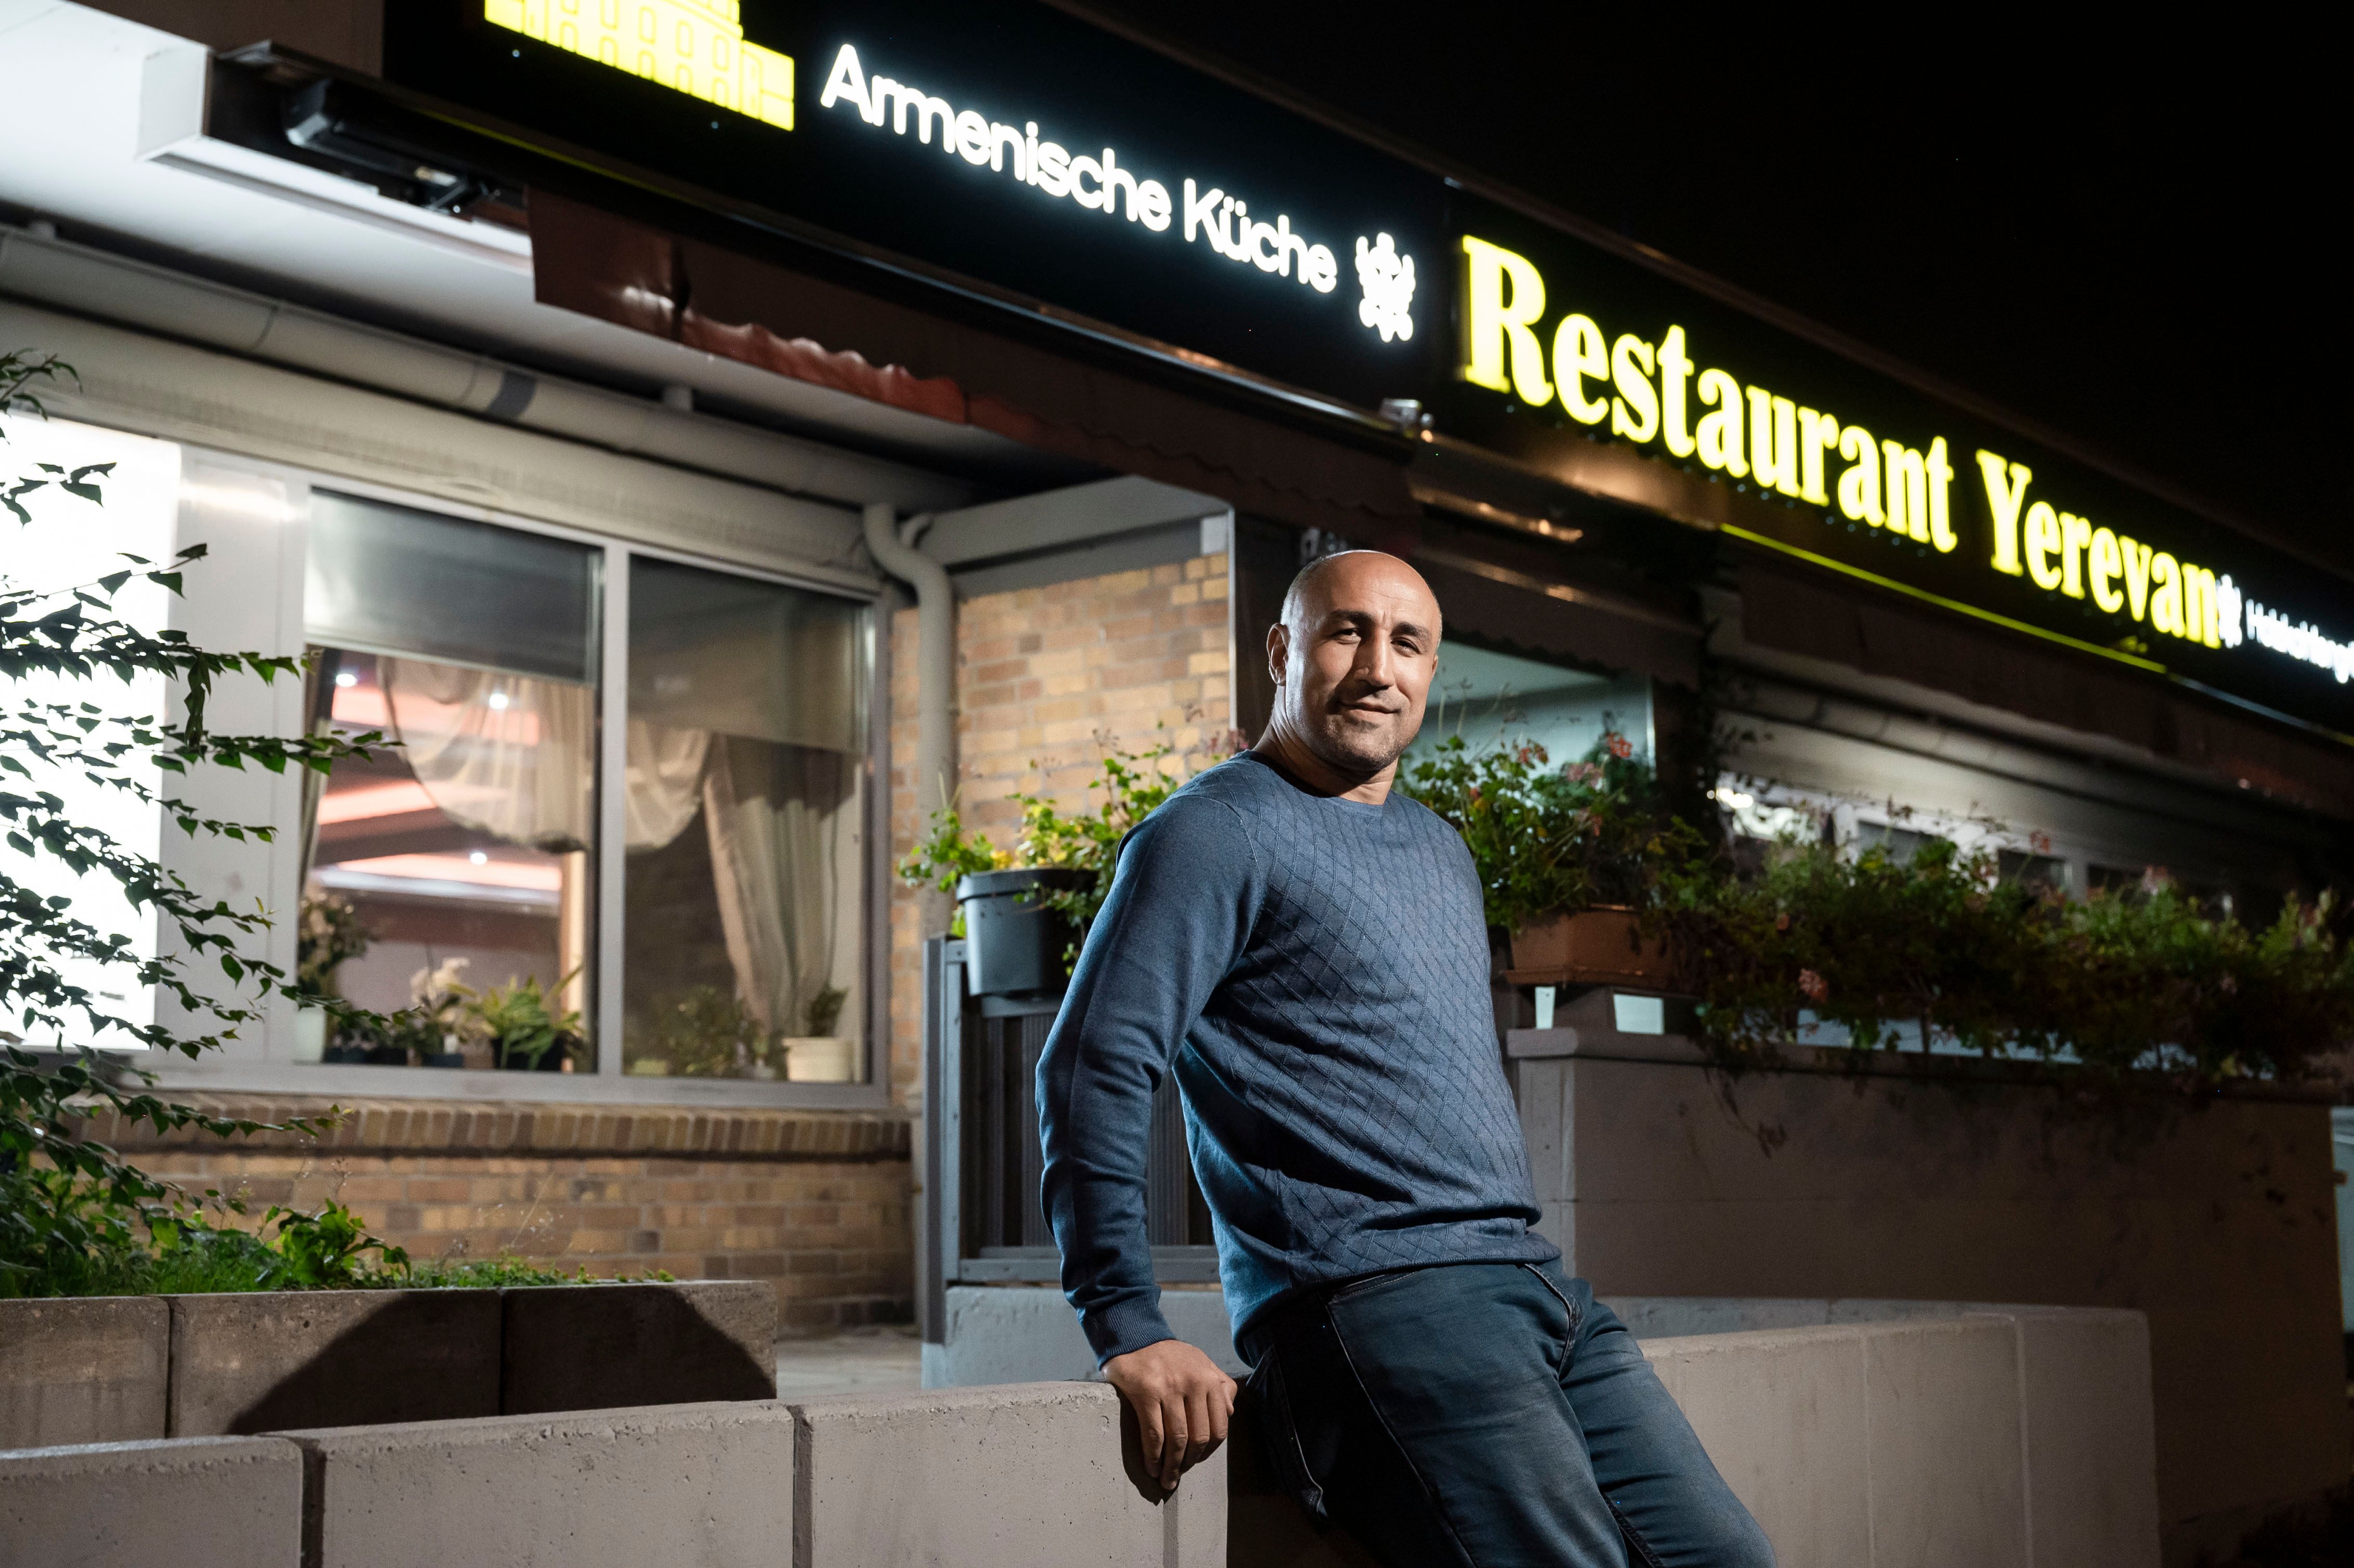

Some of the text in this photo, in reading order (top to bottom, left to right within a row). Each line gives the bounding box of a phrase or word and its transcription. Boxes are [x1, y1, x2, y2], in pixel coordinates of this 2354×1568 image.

[820, 44, 1338, 293] Armenische Küche
[1462, 235, 2221, 649] Restaurant Yerevan
